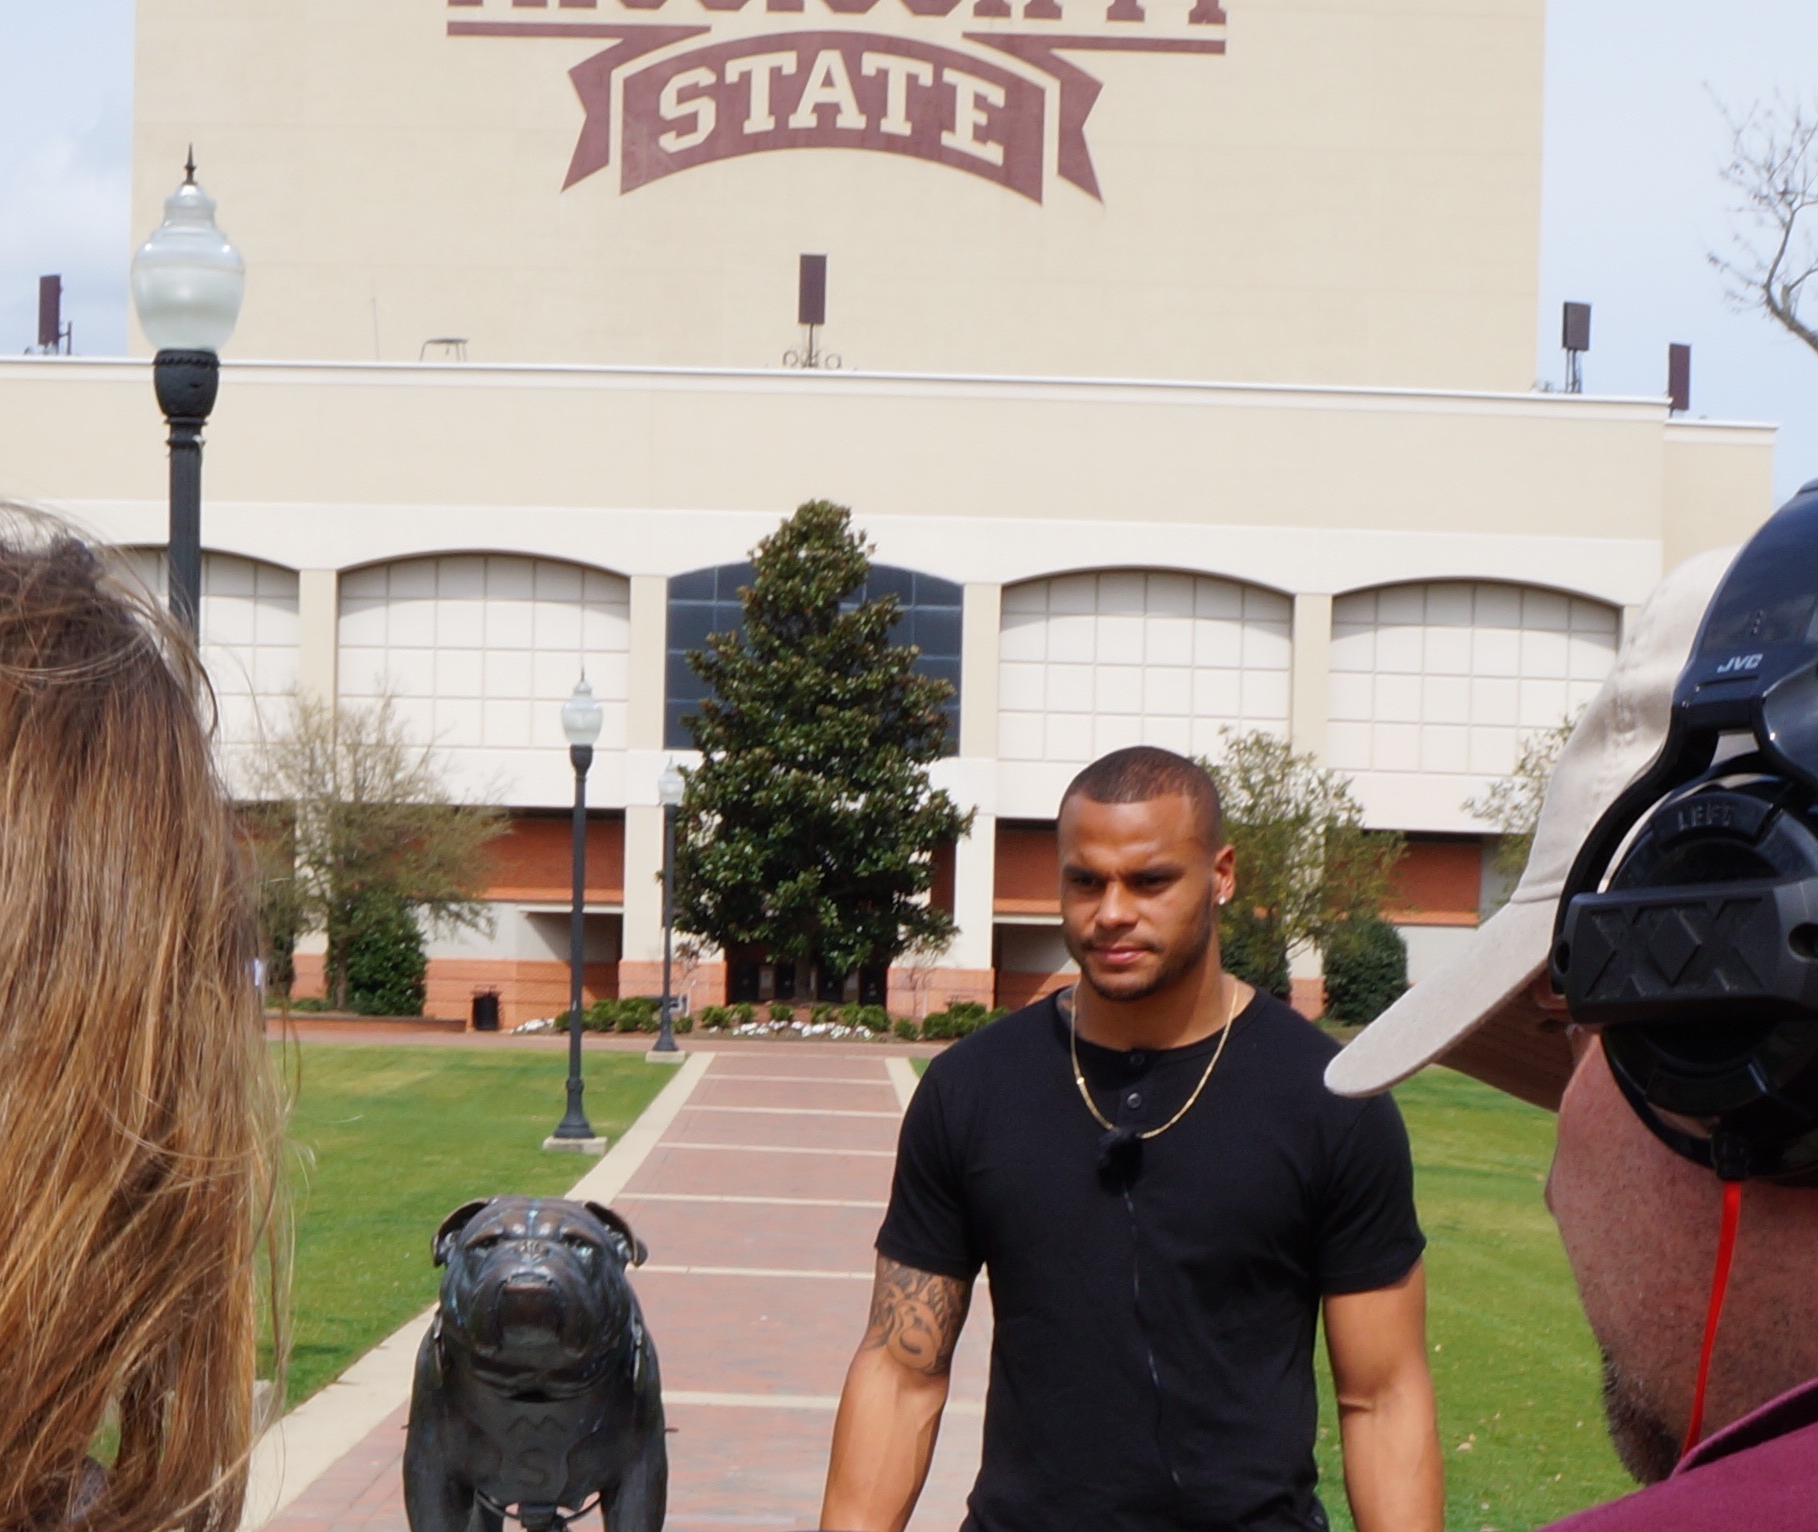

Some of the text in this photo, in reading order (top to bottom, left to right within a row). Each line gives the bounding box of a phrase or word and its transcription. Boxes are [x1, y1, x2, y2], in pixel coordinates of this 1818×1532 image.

[656, 48, 1007, 168] STATE
[1716, 652, 1764, 674] JVC
[1676, 803, 1734, 831] LEFT
